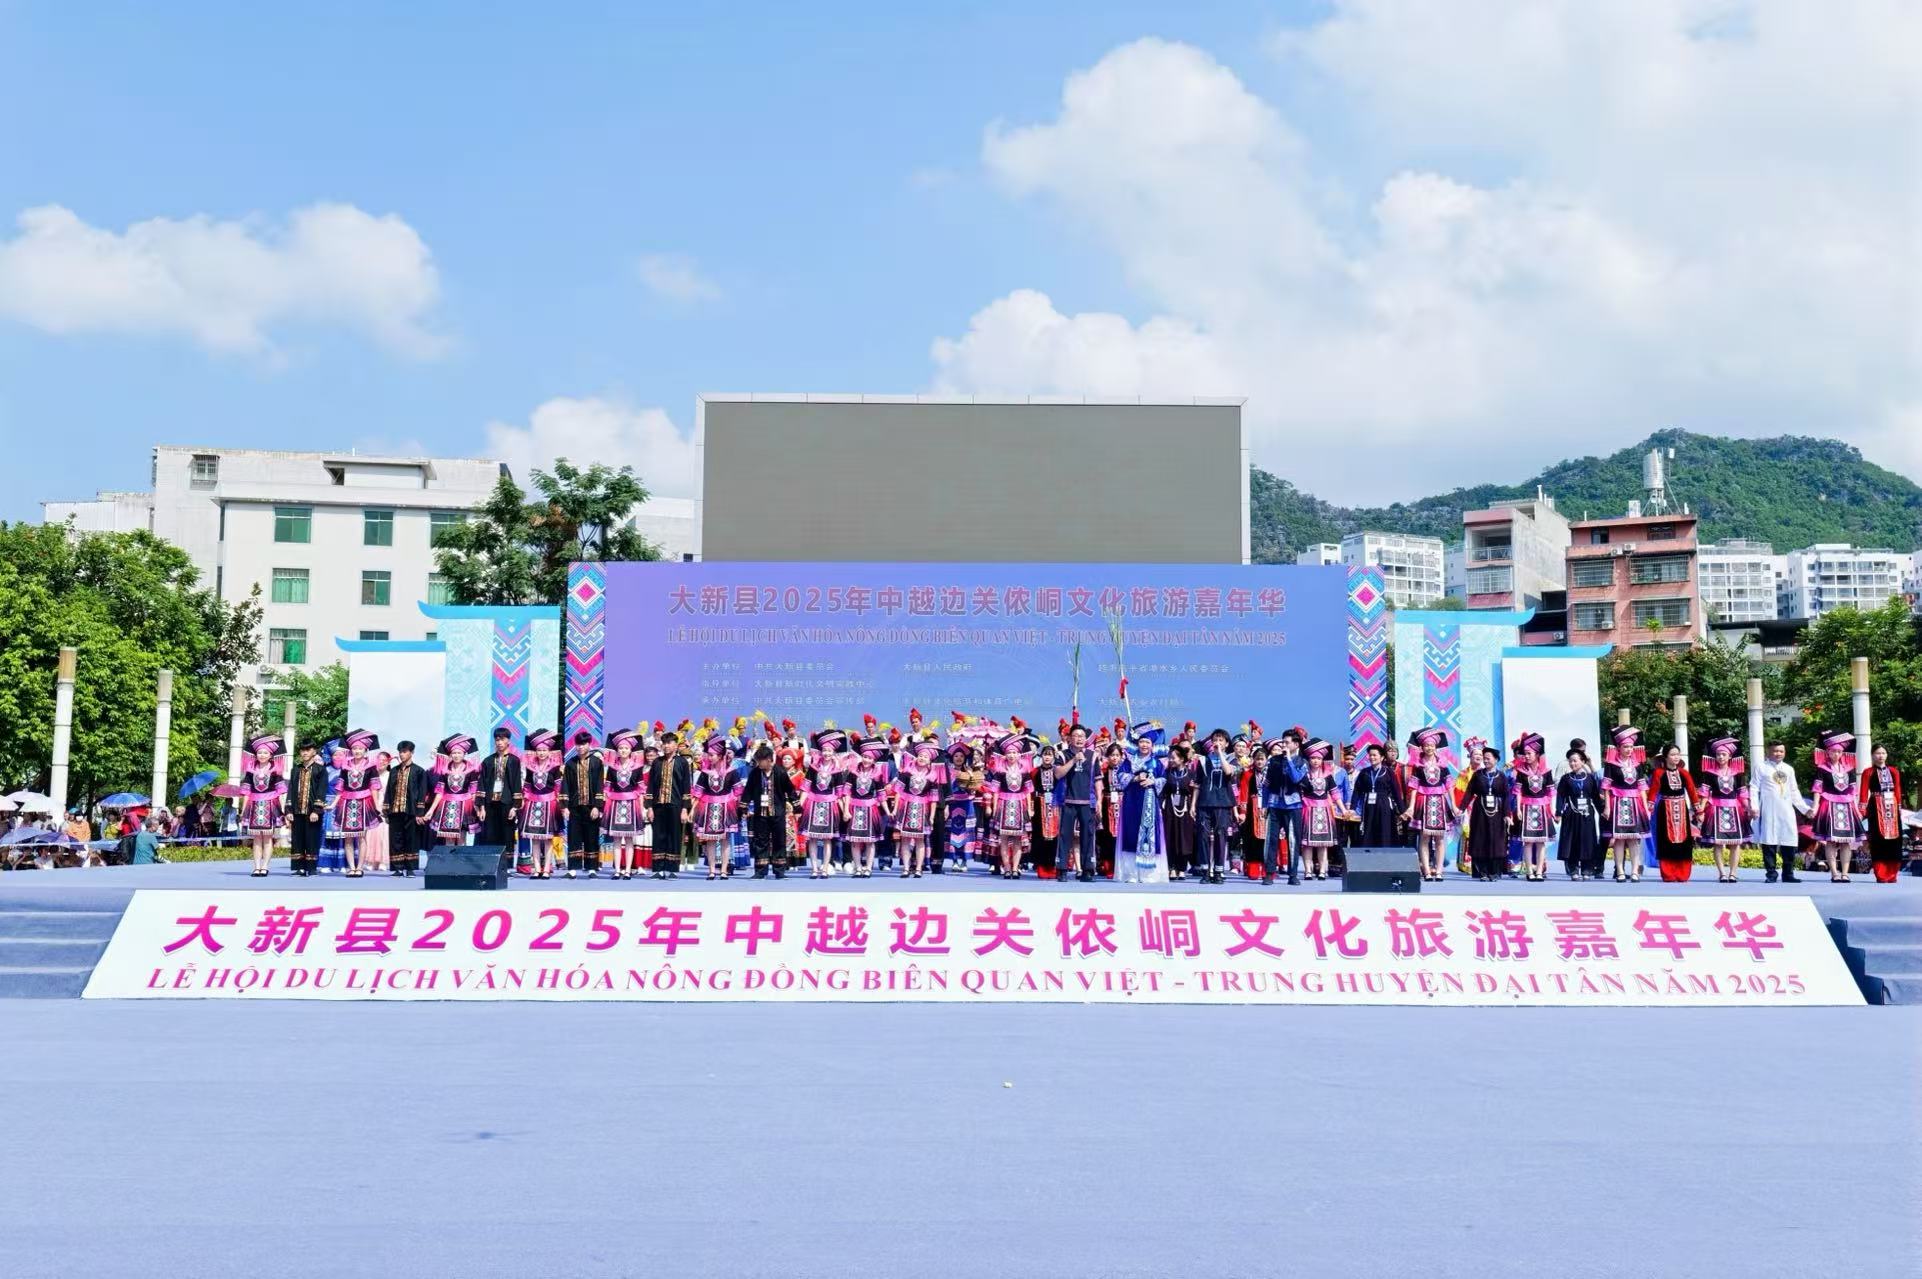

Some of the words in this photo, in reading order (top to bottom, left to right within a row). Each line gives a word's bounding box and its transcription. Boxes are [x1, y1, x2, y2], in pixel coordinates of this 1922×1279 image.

[668, 584, 1287, 618] 大新县2025年中越边关侬峒文化旅游嘉年华
[970, 629, 1010, 645] QUAN
[1107, 629, 1159, 648] UYỆN
[1257, 631, 1287, 645] 2025
[162, 904, 1783, 959] 大新县2025年中越边关侬峒文化旅游嘉年华
[147, 963, 198, 989] LỄ
[204, 966, 280, 994] HỘI
[285, 968, 338, 990] DU
[342, 968, 439, 995] LỊCH
[449, 964, 526, 990] VĂN
[536, 963, 613, 990] HÓA
[626, 963, 730, 990] NÔNG
[863, 964, 948, 991] BIÊN
[960, 969, 1064, 995] QUAN
[1072, 968, 1163, 996] VIỆT
[1193, 971, 1323, 993] TRUNG
[1335, 968, 1465, 998] HUYỆN
[1472, 972, 1539, 1000] ĐẠI
[1545, 967, 1626, 994] TÂN
[1634, 968, 1721, 995] NĂM
[1727, 973, 1806, 995] 2025
